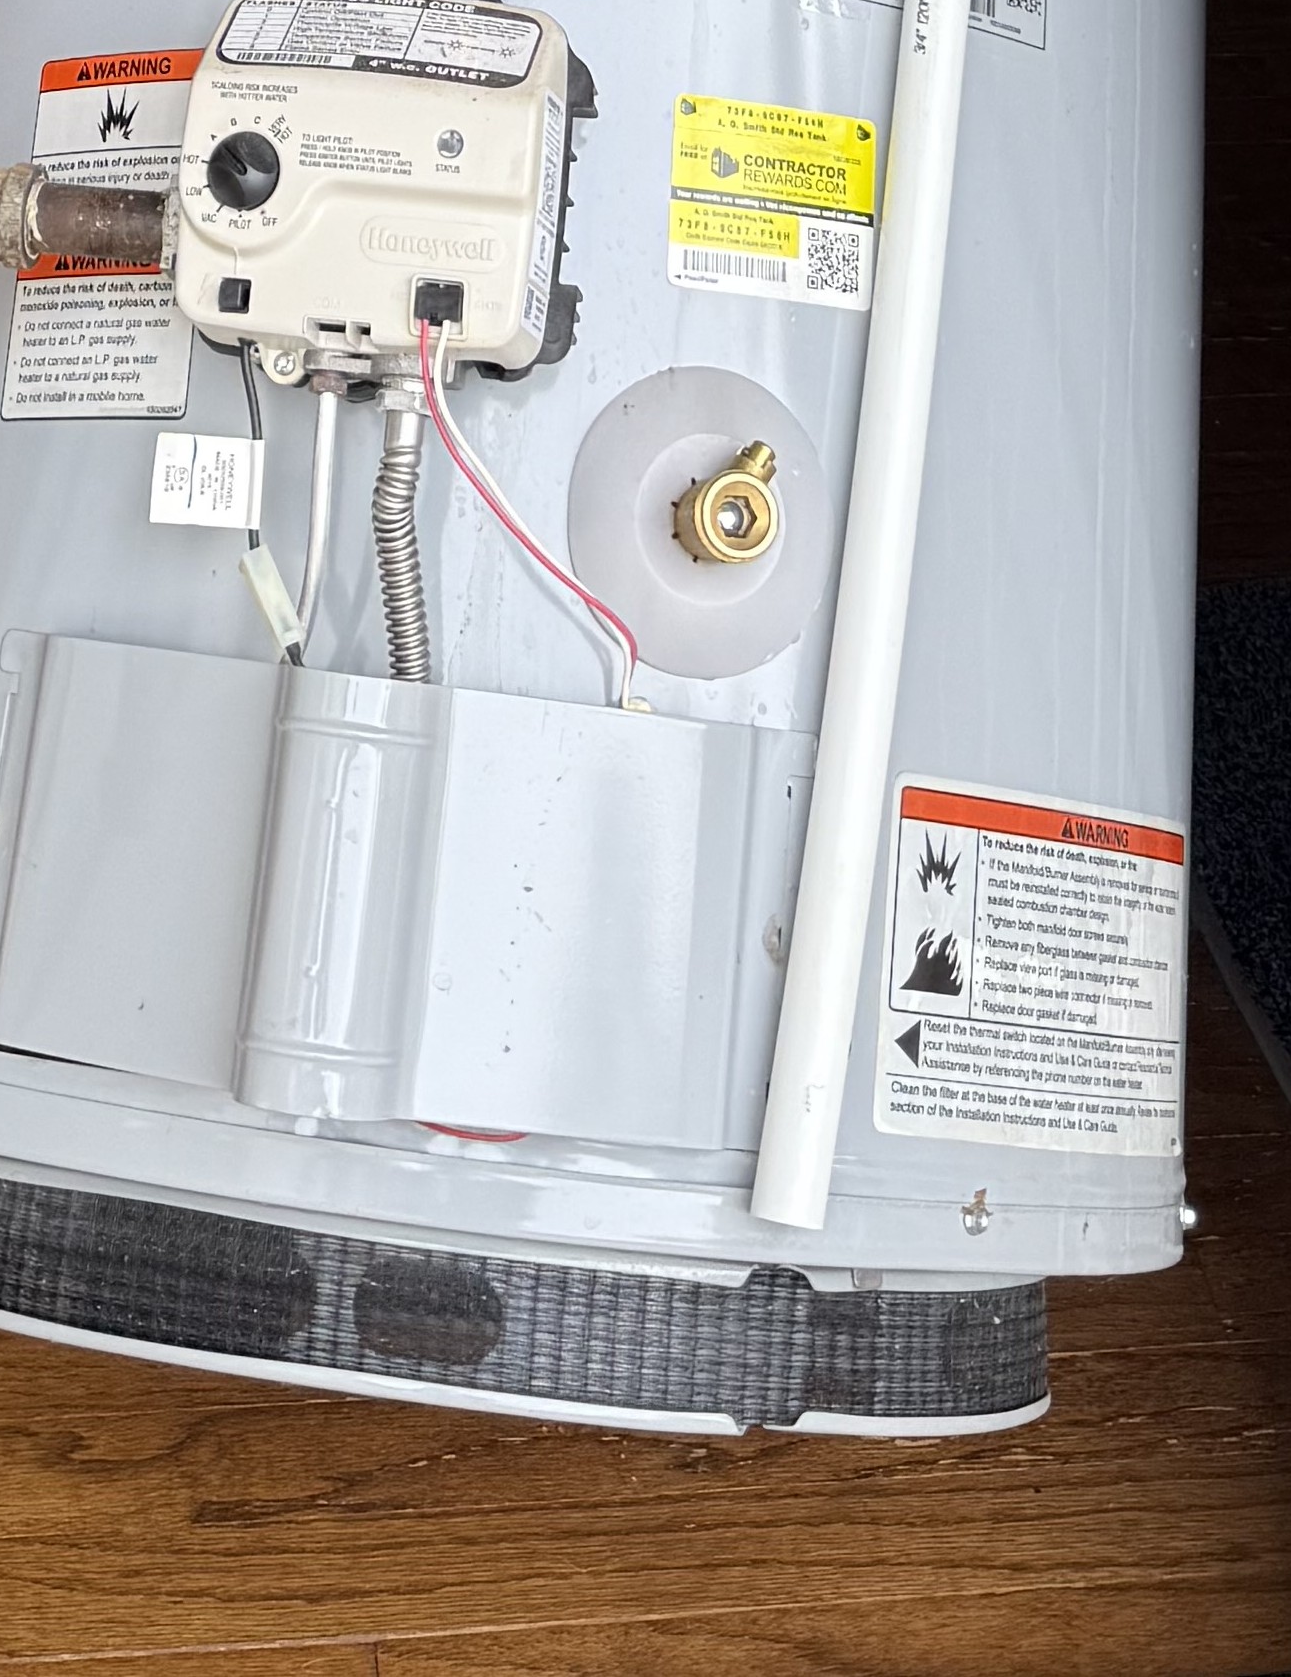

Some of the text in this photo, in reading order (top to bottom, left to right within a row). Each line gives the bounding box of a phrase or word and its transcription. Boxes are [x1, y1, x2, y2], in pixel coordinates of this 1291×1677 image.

[429, 1, 476, 13] CODE
[93, 57, 171, 80] WARNING
[425, 66, 489, 80] OUTLET
[254, 116, 261, 124] C
[210, 134, 217, 142] A
[312, 135, 332, 143] LIGHT
[92, 158, 109, 168] risk
[112, 156, 120, 167] of
[123, 154, 168, 168] explosion
[183, 154, 199, 164] HOT
[435, 164, 460, 173] STATUS
[744, 154, 846, 181] CONTRACTOR
[186, 187, 203, 196] LOW
[229, 219, 251, 229] PILOT
[262, 217, 278, 226] OFF
[368, 227, 496, 261] Honeywell
[33, 284, 60, 296] reduce
[63, 283, 76, 293] the
[78, 282, 94, 292] risk
[97, 282, 106, 292] of
[24, 321, 36, 332] Do
[37, 321, 49, 331] not
[52, 319, 83, 330] connect
[125, 320, 142, 330] gas
[1075, 821, 1129, 848] WARNING
[983, 835, 1054, 857] To reduce the risk
[924, 1018, 1000, 1039] Reset the thermal
[923, 1040, 1038, 1062] your Installation Instructions
[891, 1081, 959, 1099] Clean the filter
